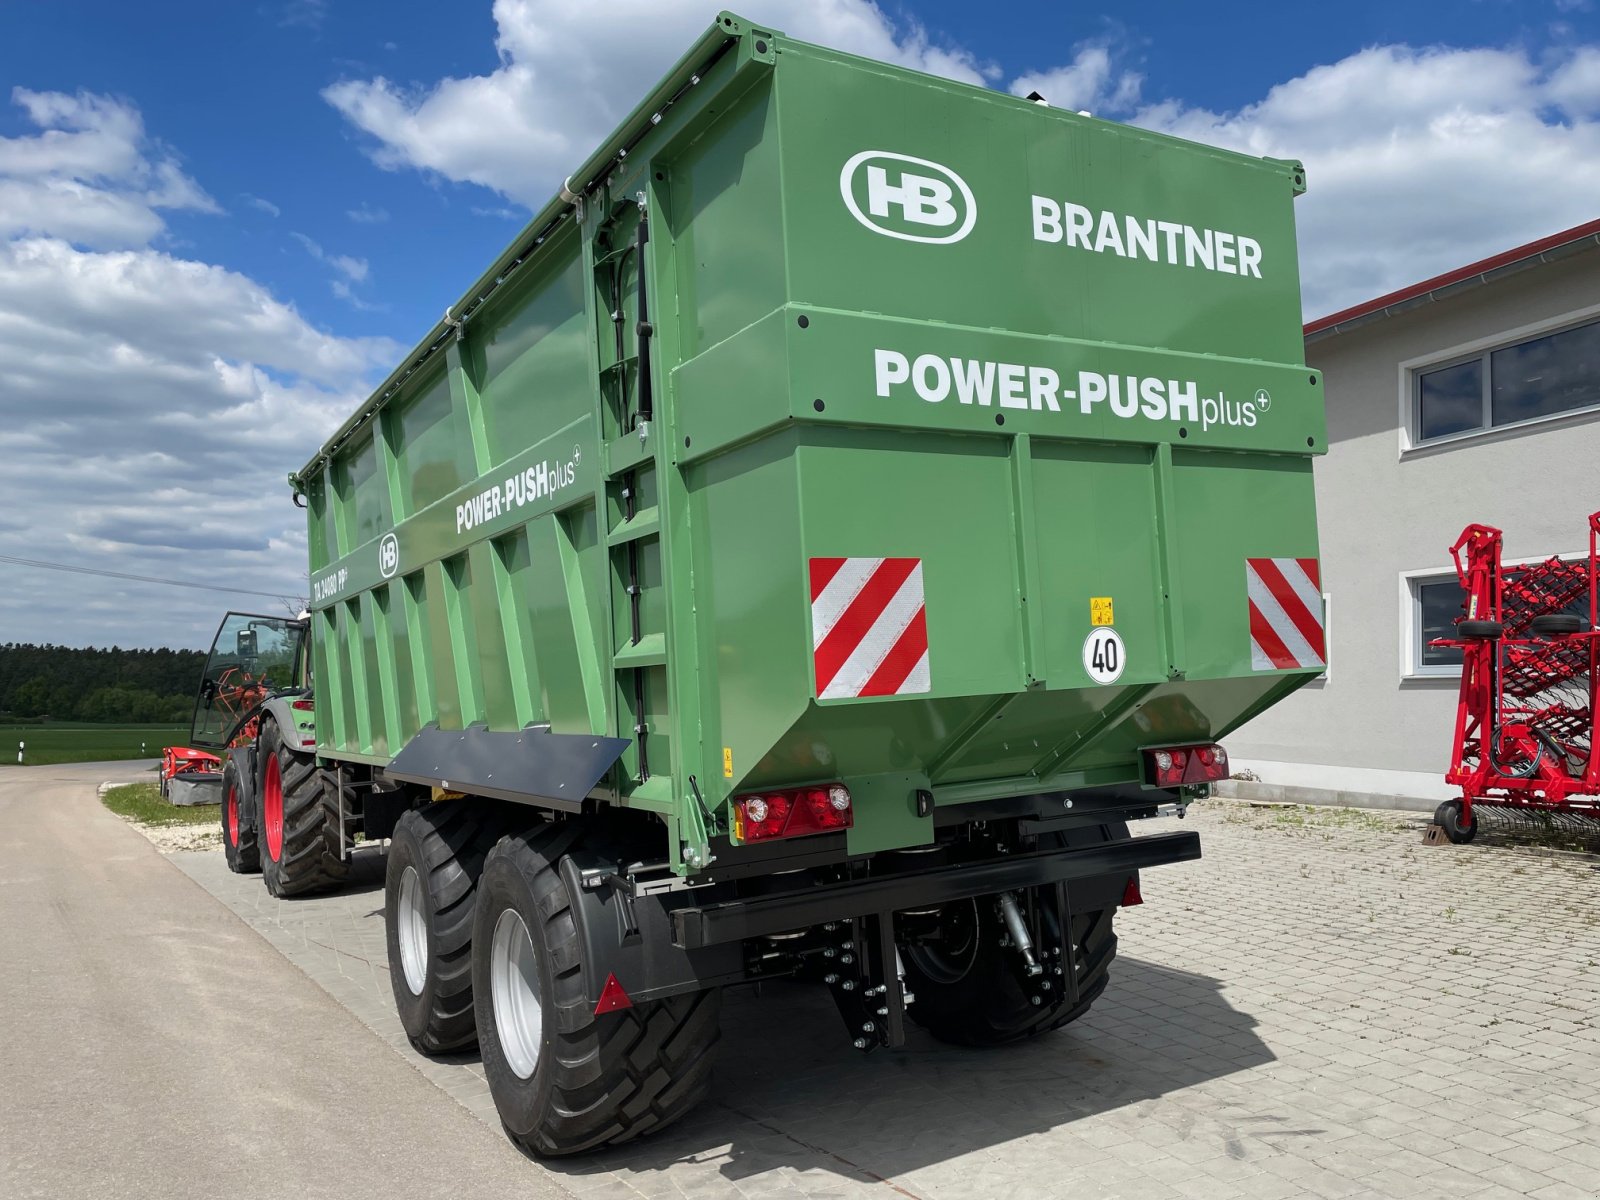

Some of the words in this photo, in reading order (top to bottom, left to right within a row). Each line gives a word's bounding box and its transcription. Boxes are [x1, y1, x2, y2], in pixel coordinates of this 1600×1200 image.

[867, 165, 957, 227] HB
[1031, 194, 1263, 279] BRANTNER
[382, 541, 396, 570] HB
[1092, 638, 1118, 673] 40
